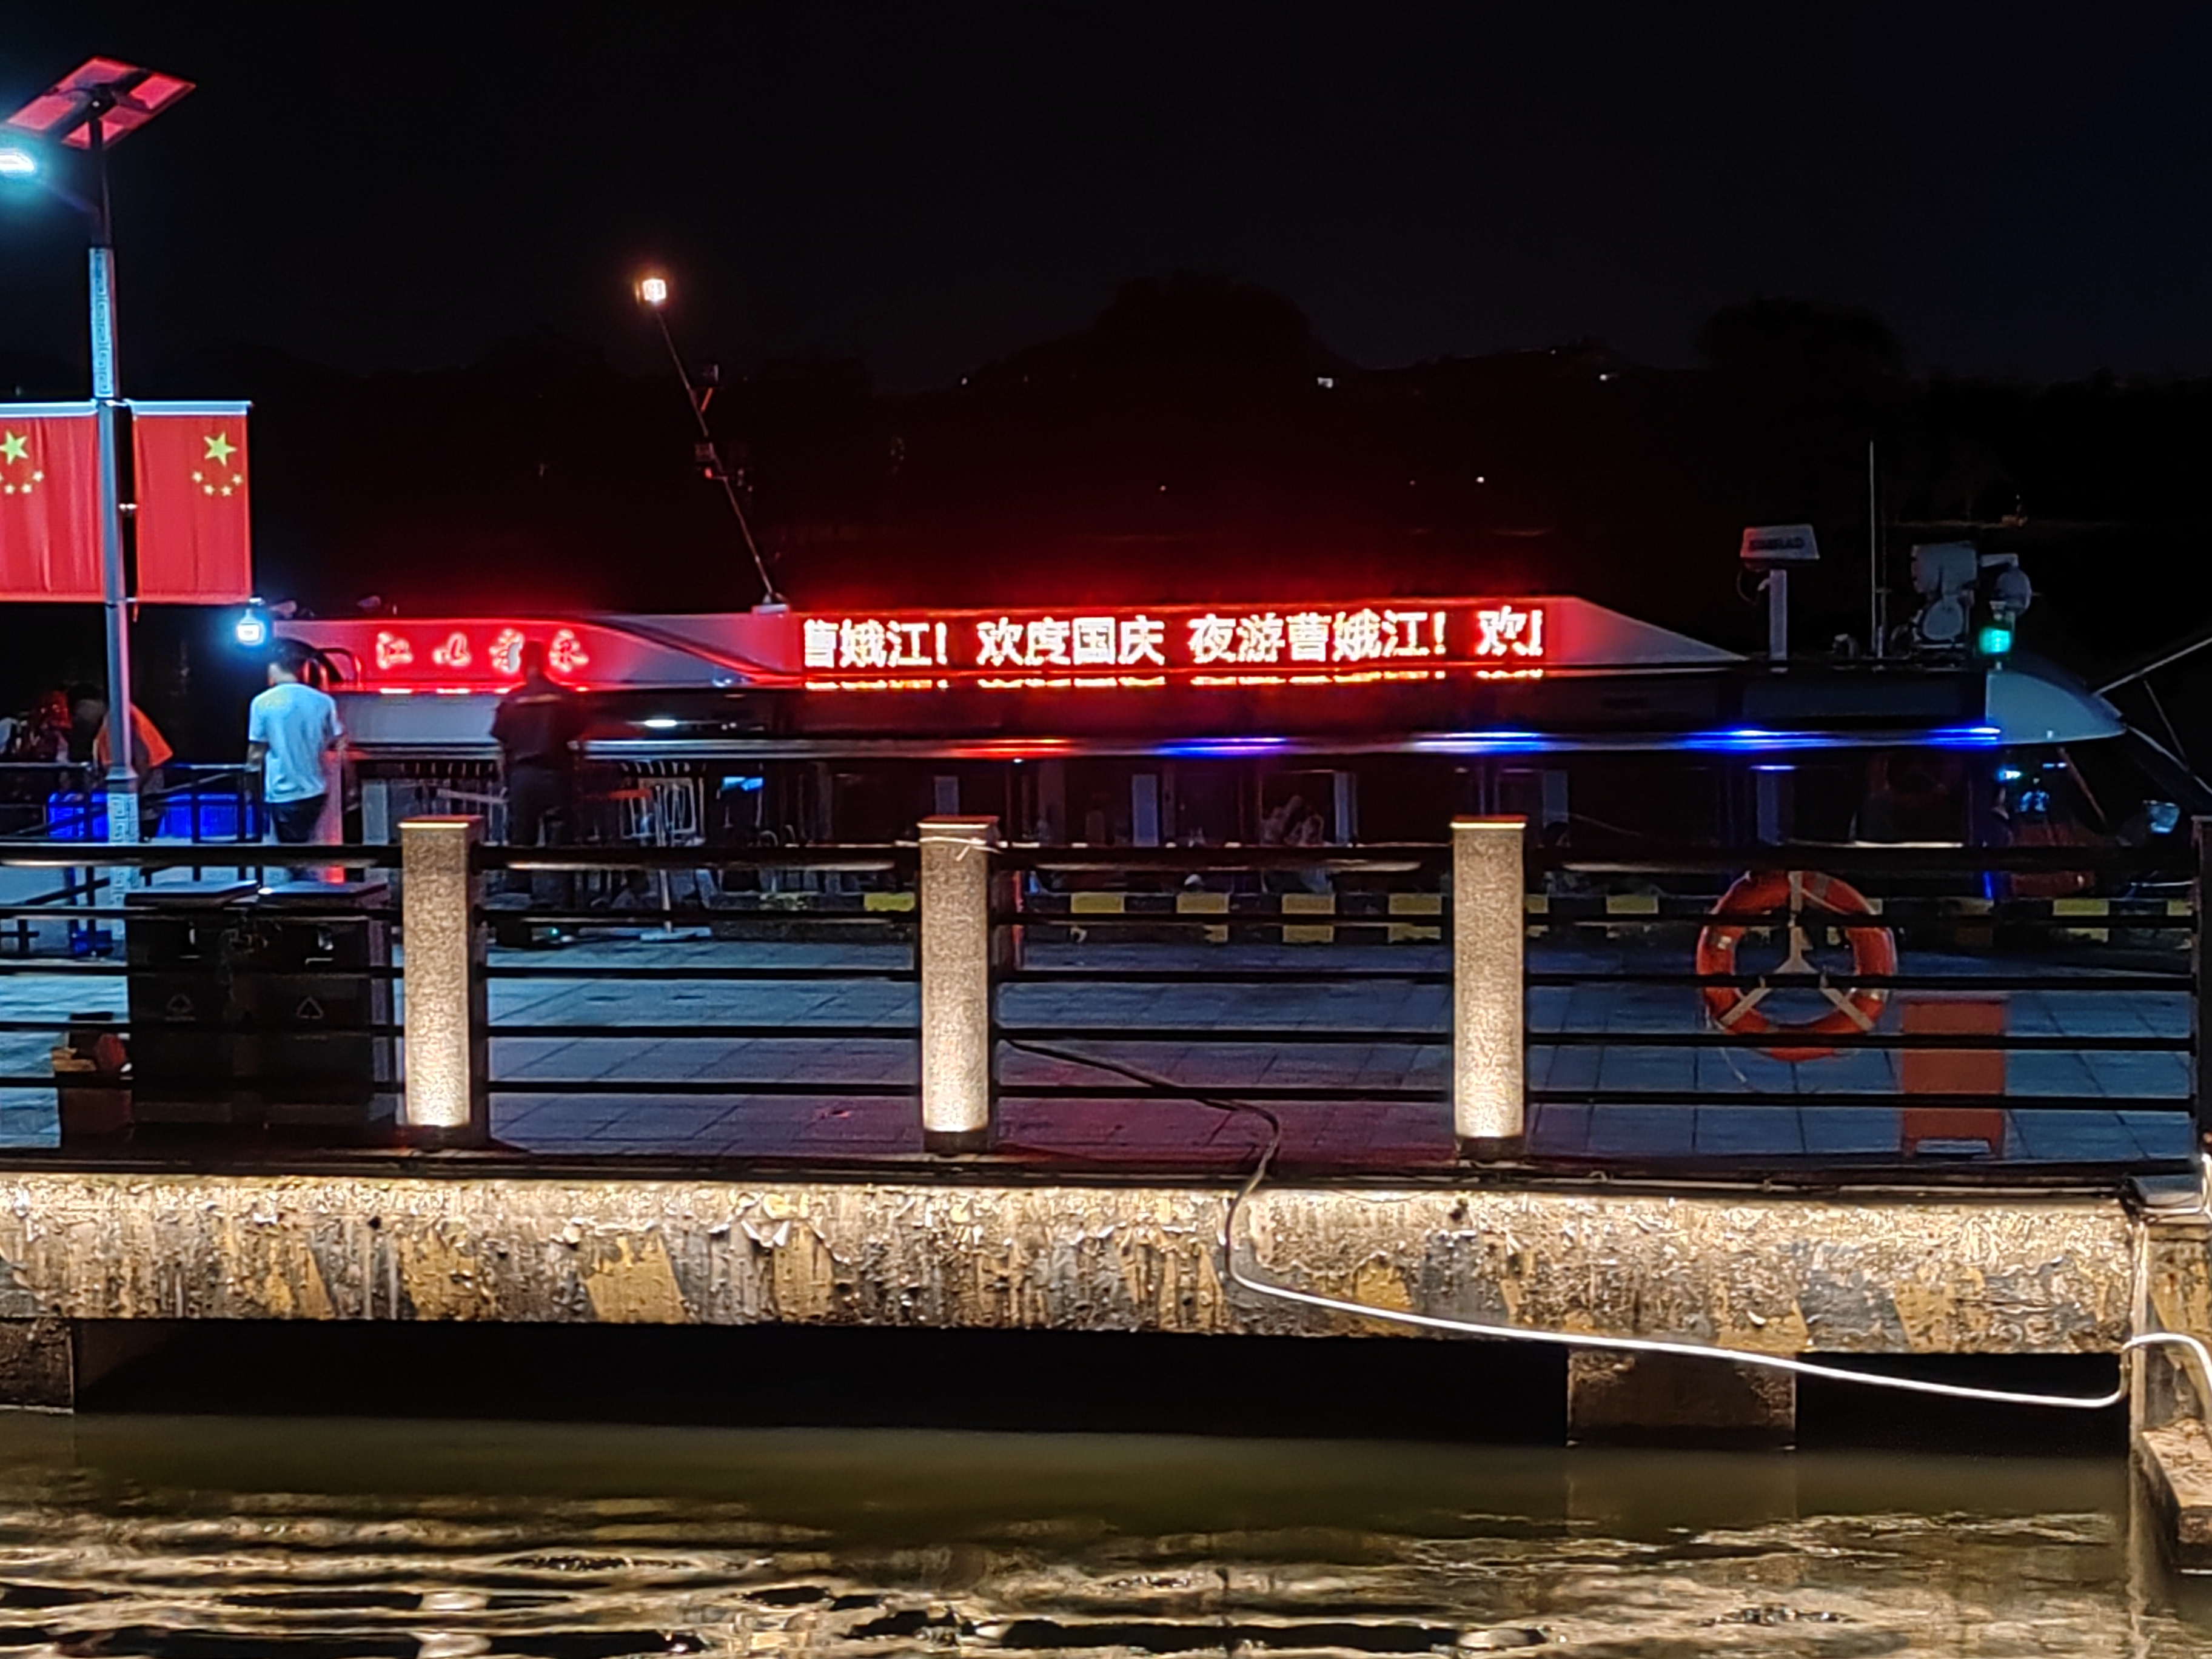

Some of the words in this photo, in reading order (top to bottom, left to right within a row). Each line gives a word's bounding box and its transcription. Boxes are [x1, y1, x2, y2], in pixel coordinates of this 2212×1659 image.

[977, 615, 1165, 666] 欢度国庆
[1188, 609, 1446, 663] 夜游曹娥江!
